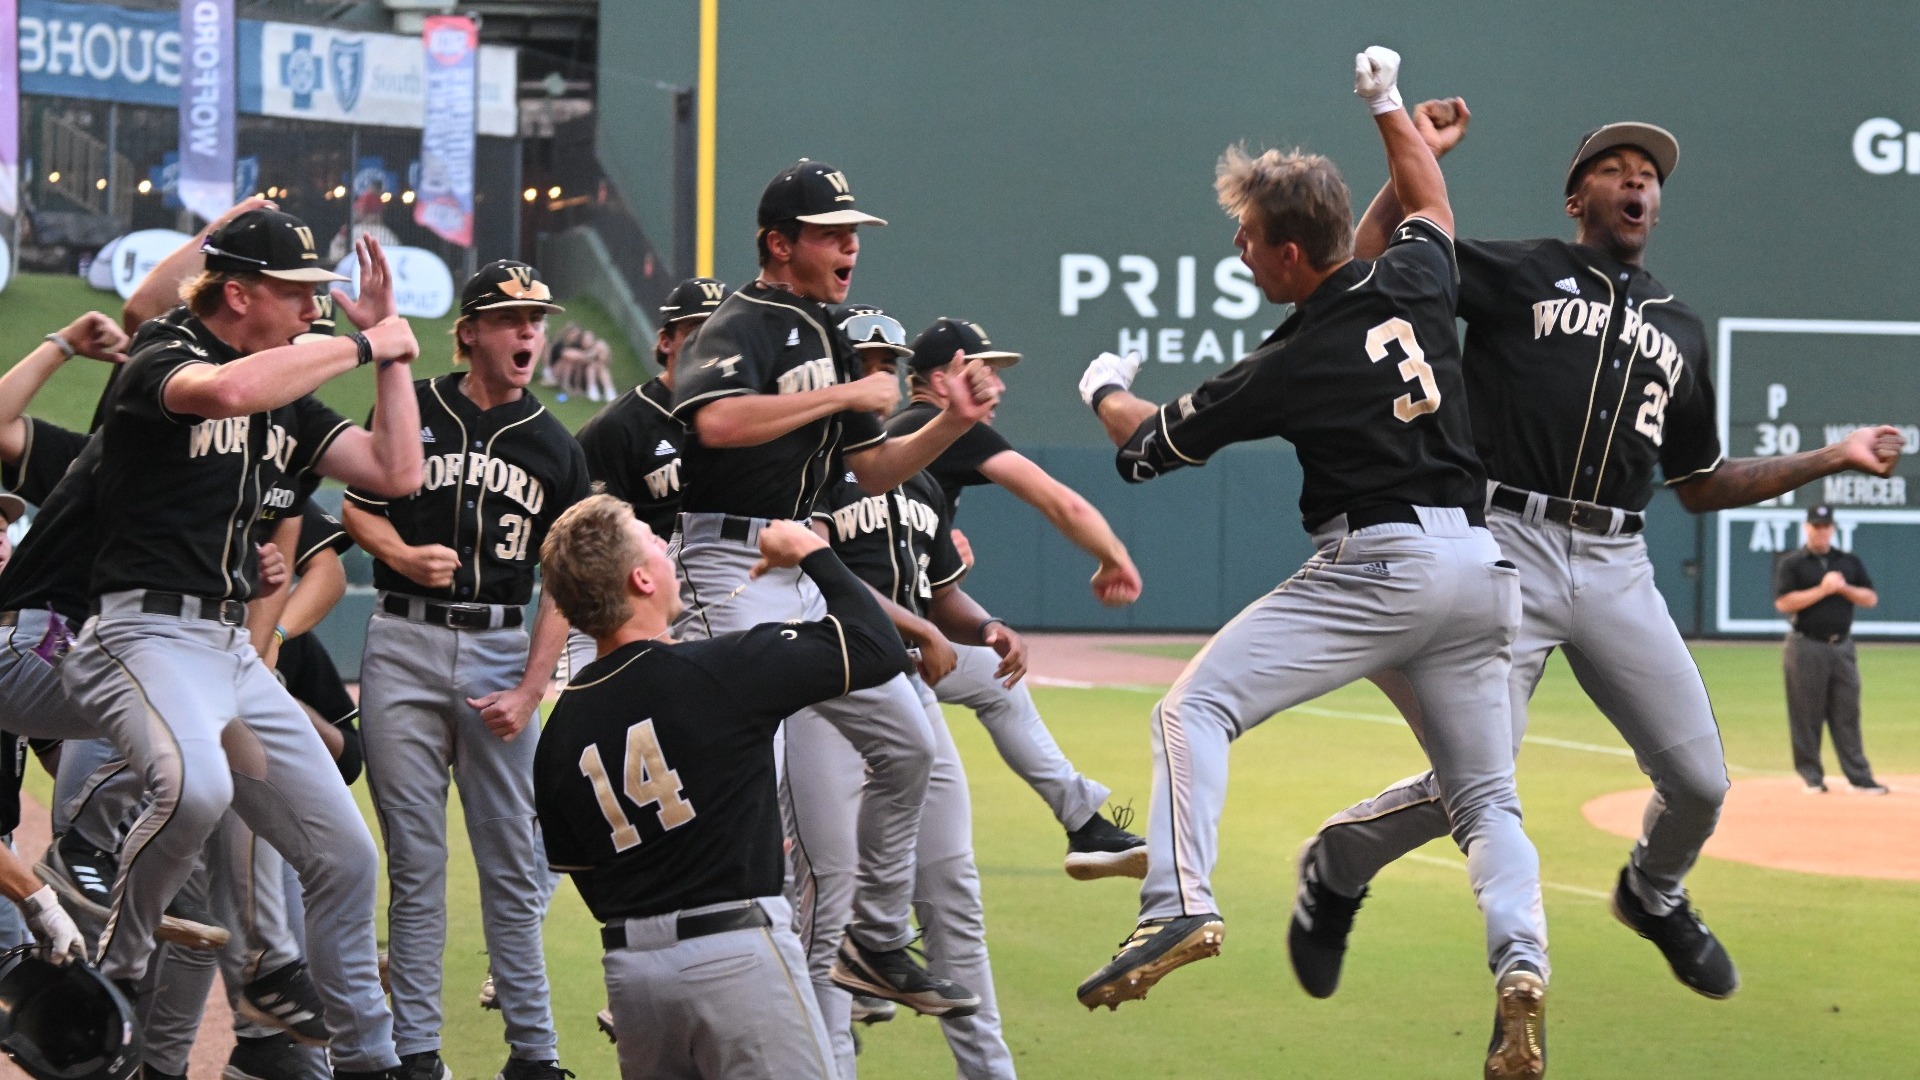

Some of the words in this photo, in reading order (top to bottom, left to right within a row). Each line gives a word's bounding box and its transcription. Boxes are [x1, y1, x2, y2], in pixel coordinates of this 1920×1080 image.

[824, 170, 850, 193] W
[506, 266, 533, 291] W
[701, 283, 725, 300] W
[1365, 316, 1441, 423] 3
[1767, 383, 1788, 420] P
[1755, 423, 1800, 456] 30
[409, 451, 545, 515] OFFORD
[1824, 476, 1907, 505] MERCER
[494, 513, 532, 561] 31
[1749, 521, 1791, 552] AT
[578, 717, 697, 854] 14
